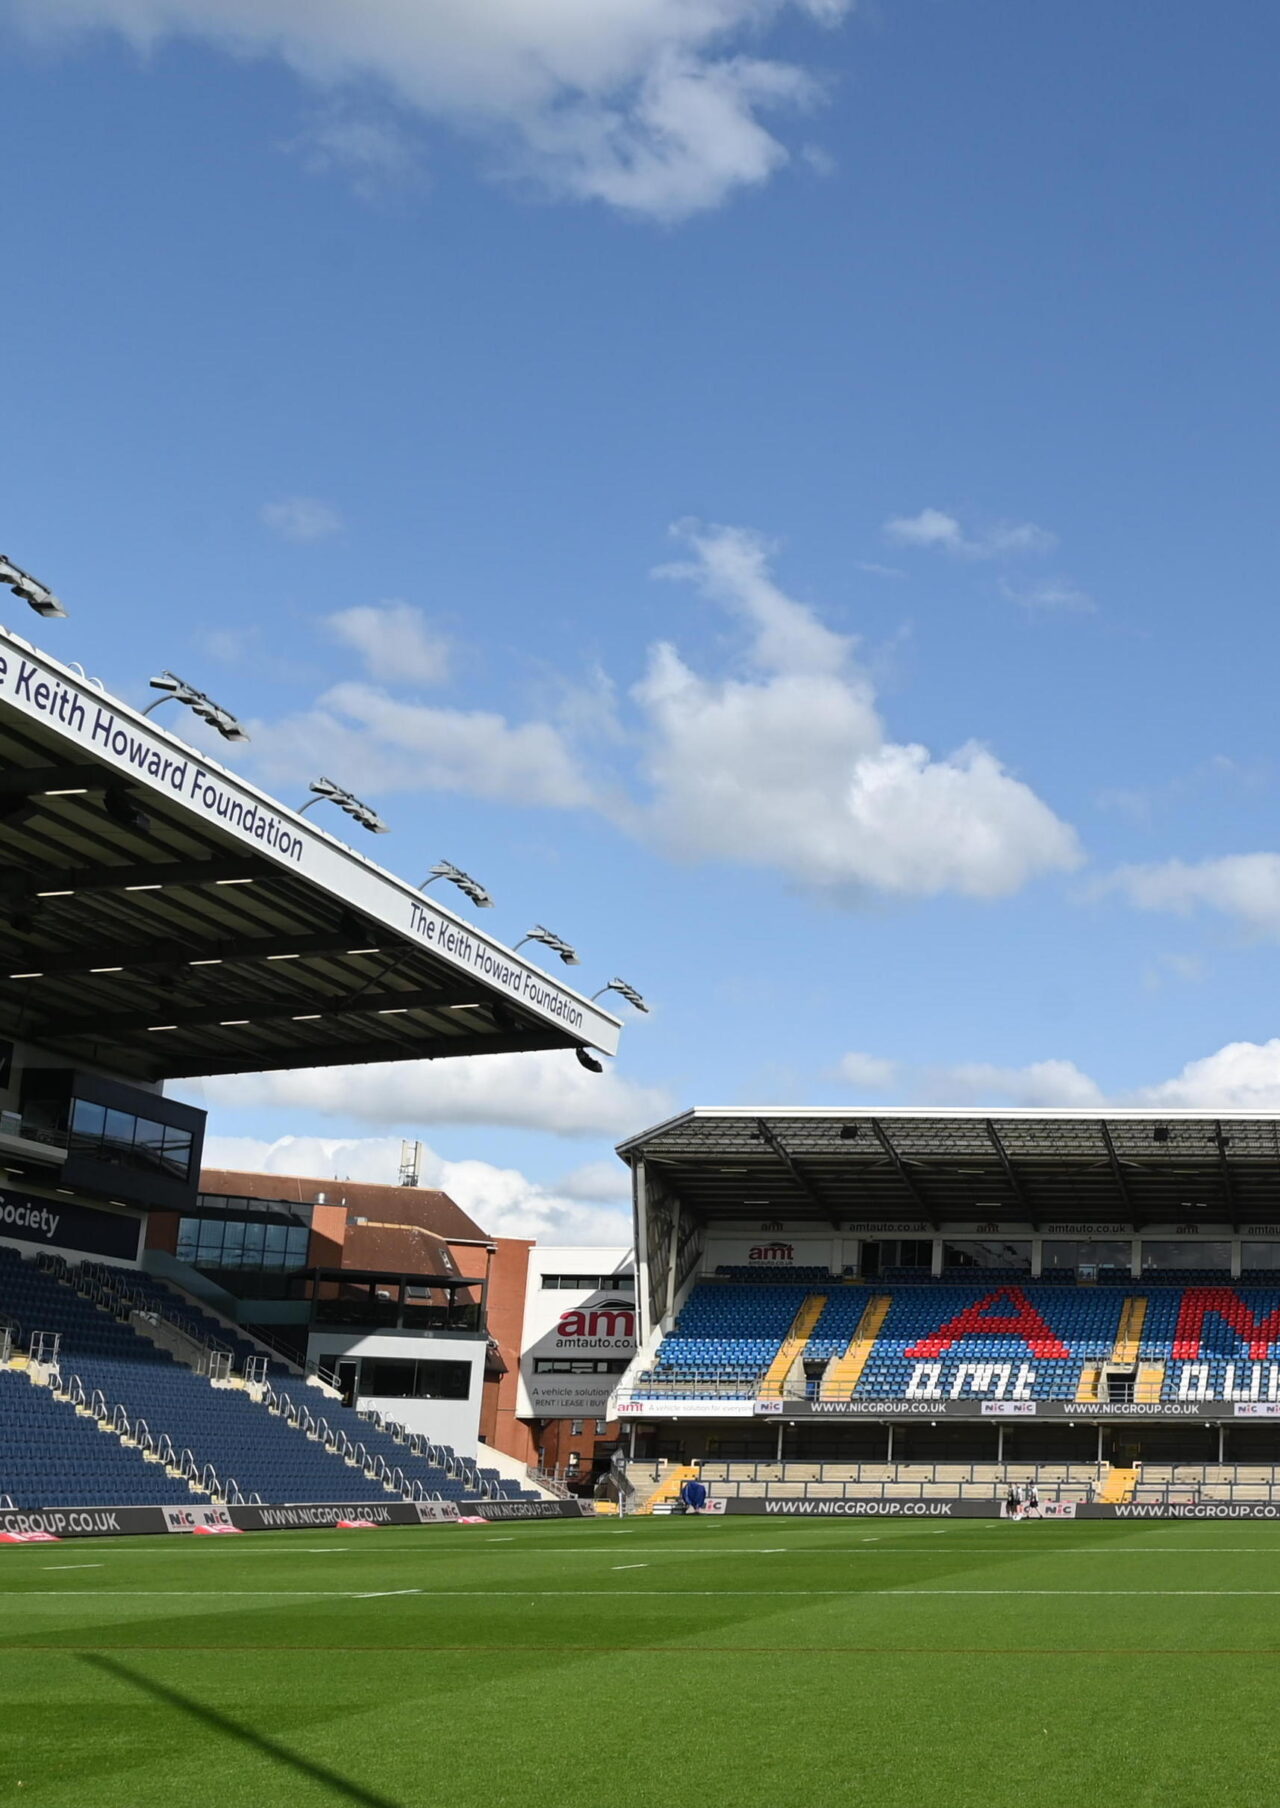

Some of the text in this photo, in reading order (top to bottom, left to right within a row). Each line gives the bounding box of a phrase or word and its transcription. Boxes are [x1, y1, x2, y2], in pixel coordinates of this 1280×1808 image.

[15, 661, 85, 731] Keith
[91, 708, 187, 792] Howard
[191, 769, 303, 862] Foundation
[410, 902, 583, 1028] The Keith Howard Foundation
[849, 1223, 927, 1232] amtauto.co.uk
[1048, 1224, 1126, 1234] amtauto.co.uk
[749, 1245, 794, 1260] amt
[557, 1311, 634, 1337] am
[532, 1387, 539, 1395] A
[541, 1387, 572, 1396] vehicle
[535, 1399, 555, 1407] RENT
[560, 1399, 584, 1407] LEASE
[617, 1404, 643, 1412] amt
[811, 1402, 947, 1412] WWW.NICGROUP.CO.UK
[1064, 1403, 1199, 1413] WWW.NICGROUP.CO.UK
[475, 1502, 563, 1518] WWW.NICGROUP.CO.UK
[765, 1500, 952, 1514] WWW.NICGROUP.CO.UK
[258, 1507, 391, 1526] WWW.NICGROUP.CO.UK
